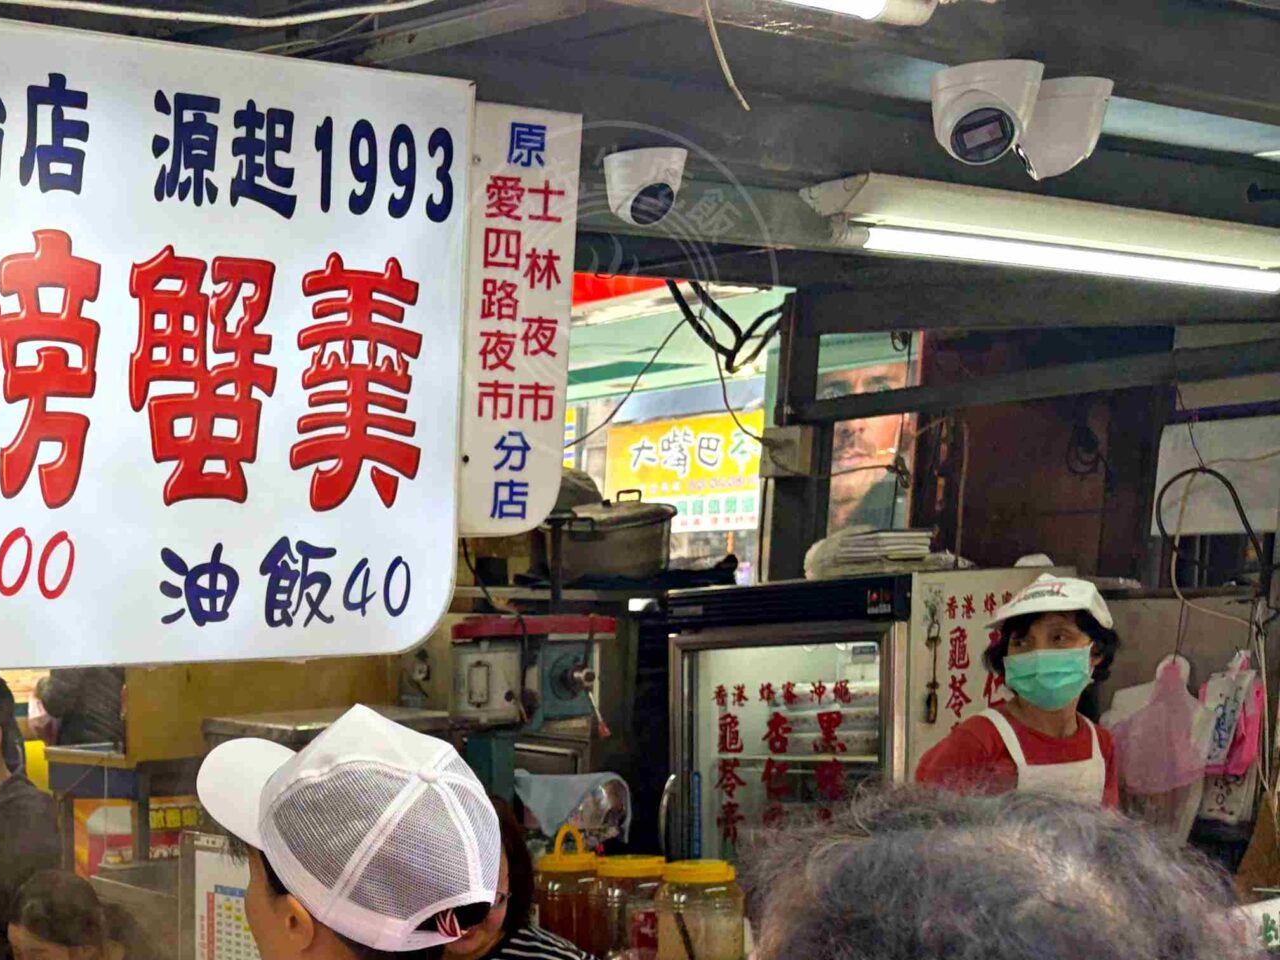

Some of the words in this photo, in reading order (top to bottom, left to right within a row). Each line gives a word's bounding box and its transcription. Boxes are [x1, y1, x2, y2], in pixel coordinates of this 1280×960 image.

[154, 91, 455, 223] 源起1993
[507, 121, 547, 168] 原
[477, 176, 525, 422] 愛四路夜市
[518, 178, 566, 424] 士林夜市
[489, 431, 531, 520] 分店
